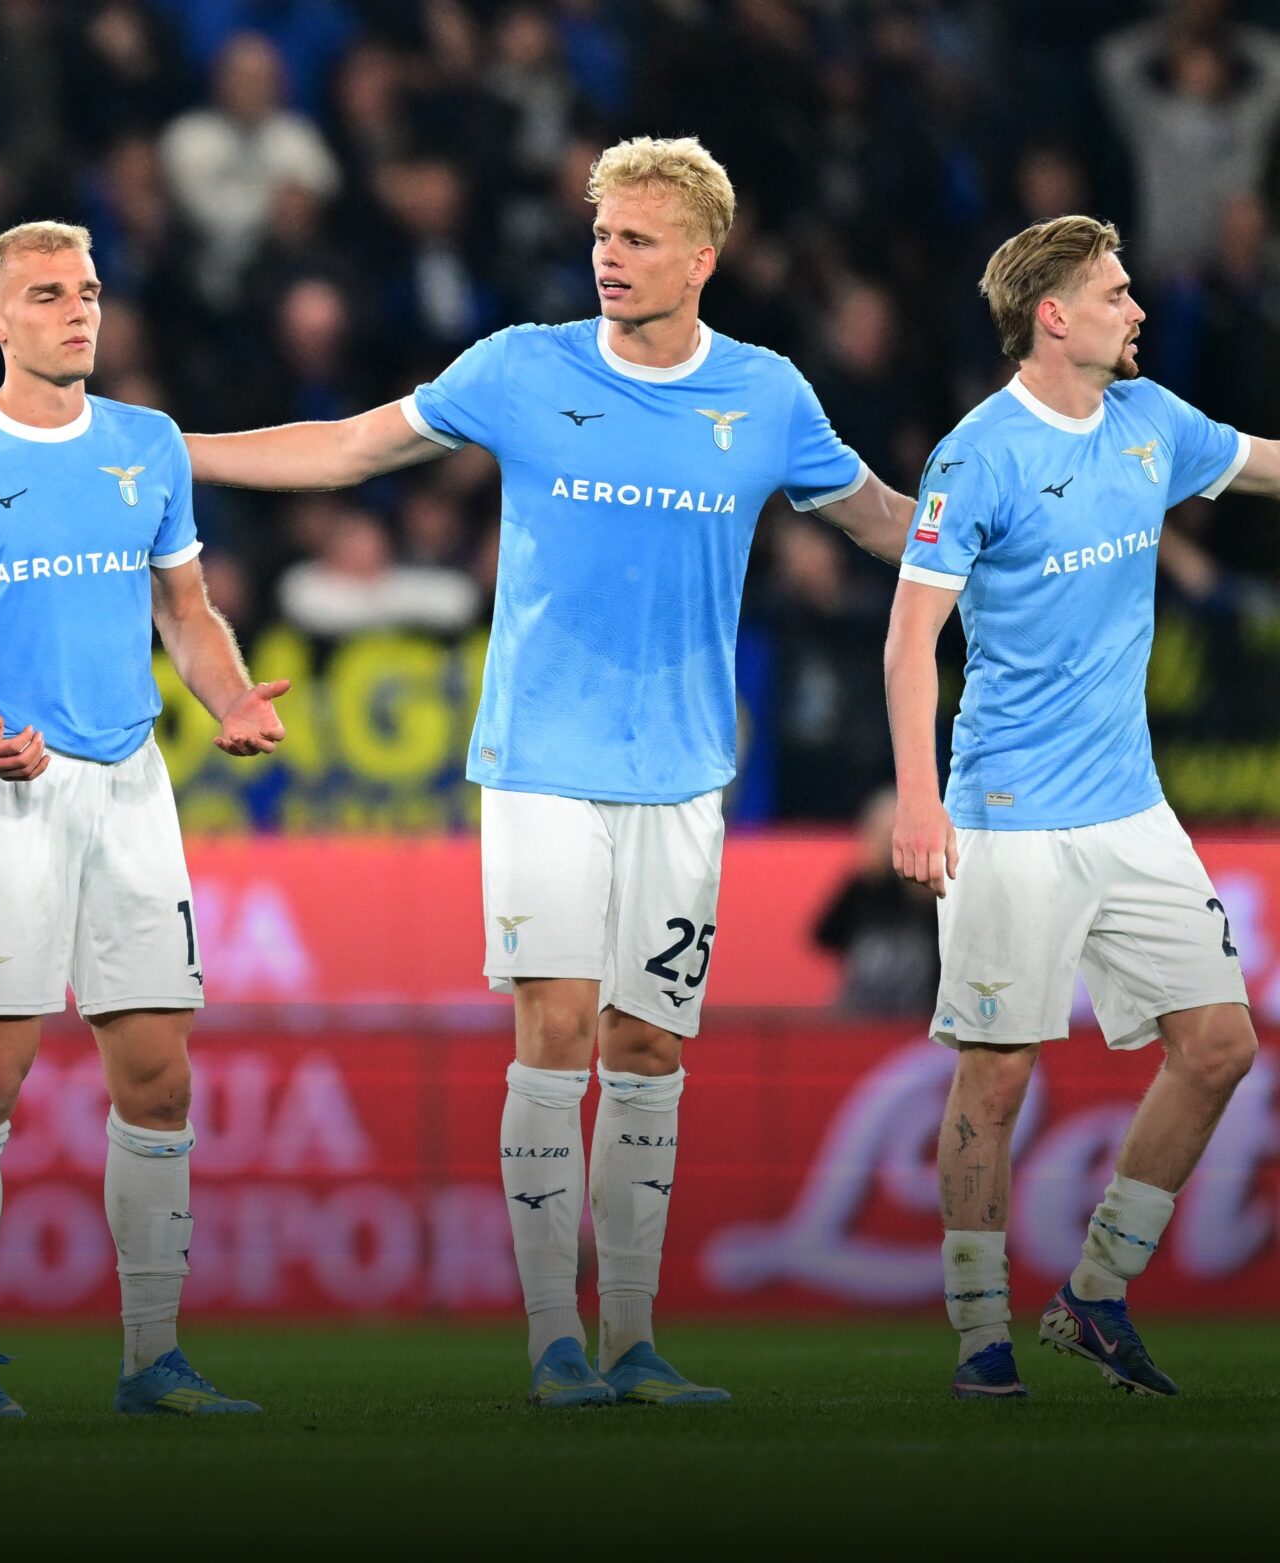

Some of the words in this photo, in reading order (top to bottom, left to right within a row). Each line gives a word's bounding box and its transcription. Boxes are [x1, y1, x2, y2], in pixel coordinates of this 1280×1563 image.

[551, 477, 736, 514] AEROITALIA
[1042, 523, 1162, 577] AEROITAL
[644, 917, 717, 988] 25
